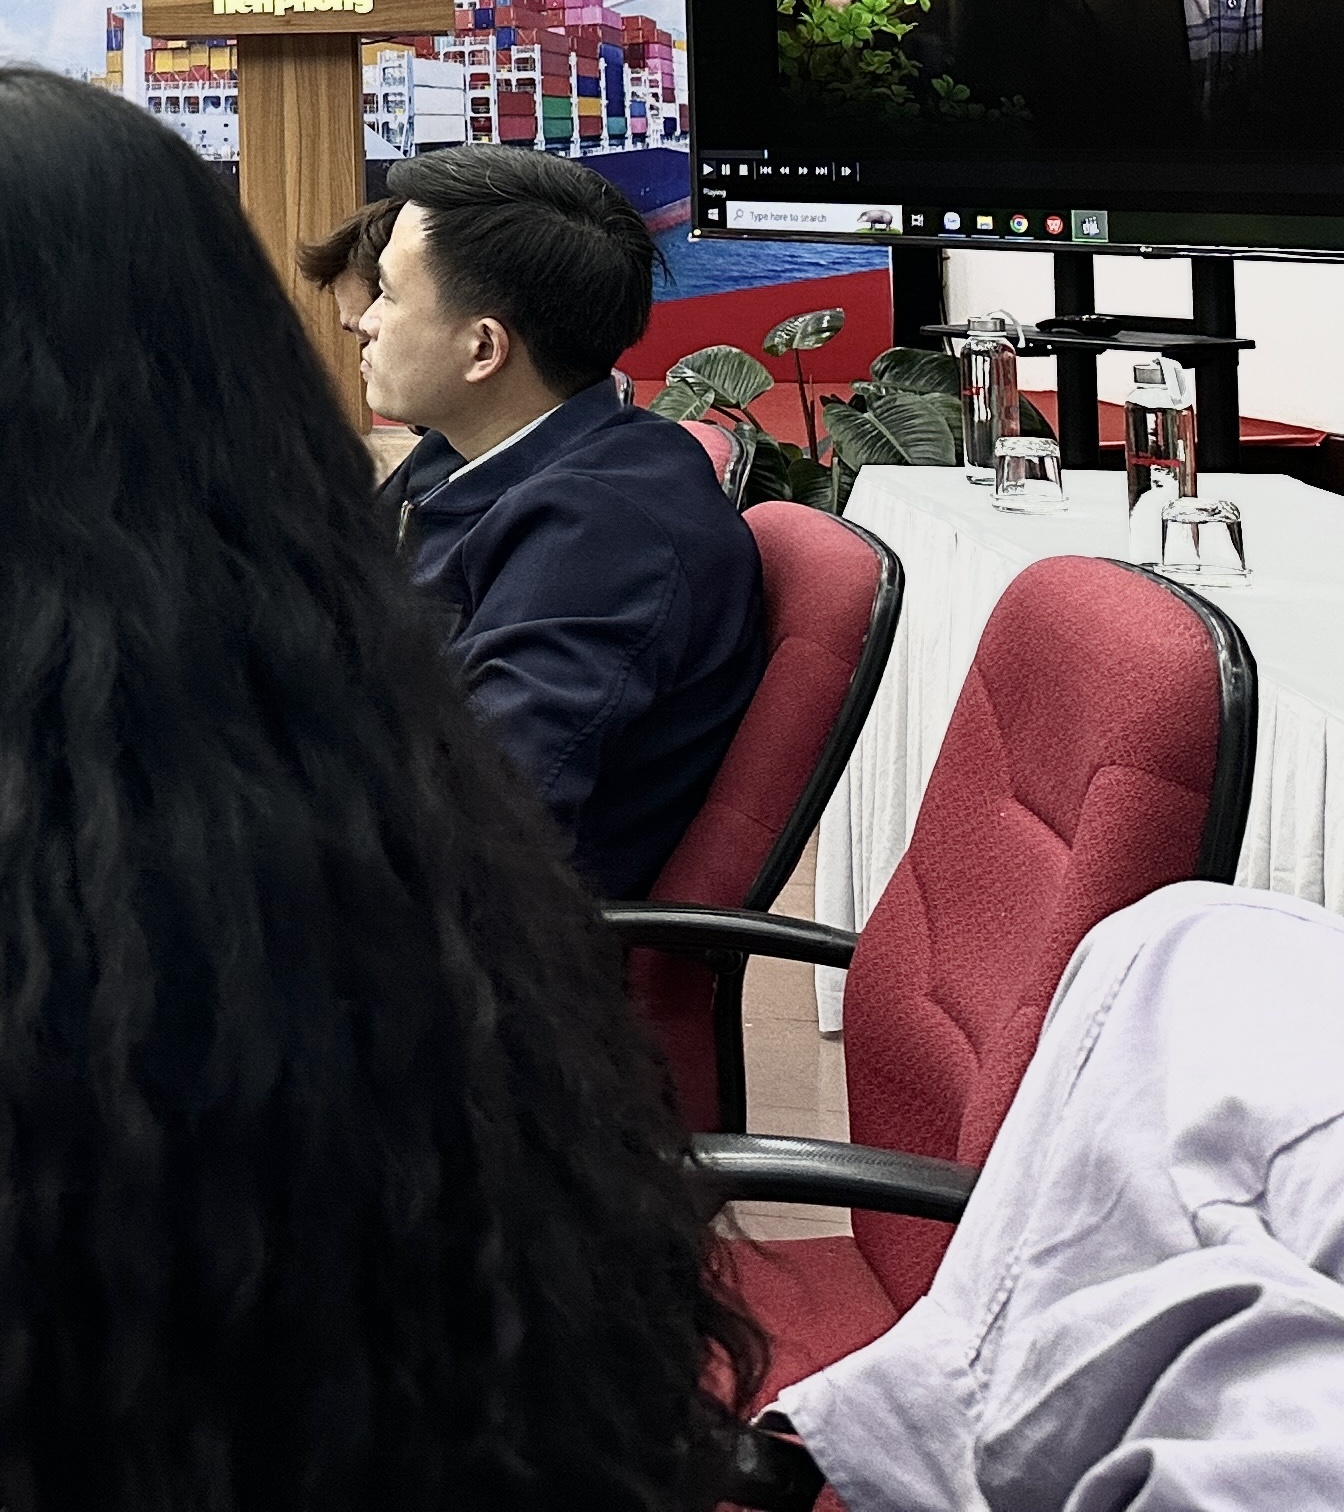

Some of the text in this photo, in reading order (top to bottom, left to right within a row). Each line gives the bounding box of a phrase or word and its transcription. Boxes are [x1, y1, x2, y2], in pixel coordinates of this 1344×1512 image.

[750, 211, 769, 222] Type
[770, 210, 788, 222] here
[801, 213, 827, 223] search
